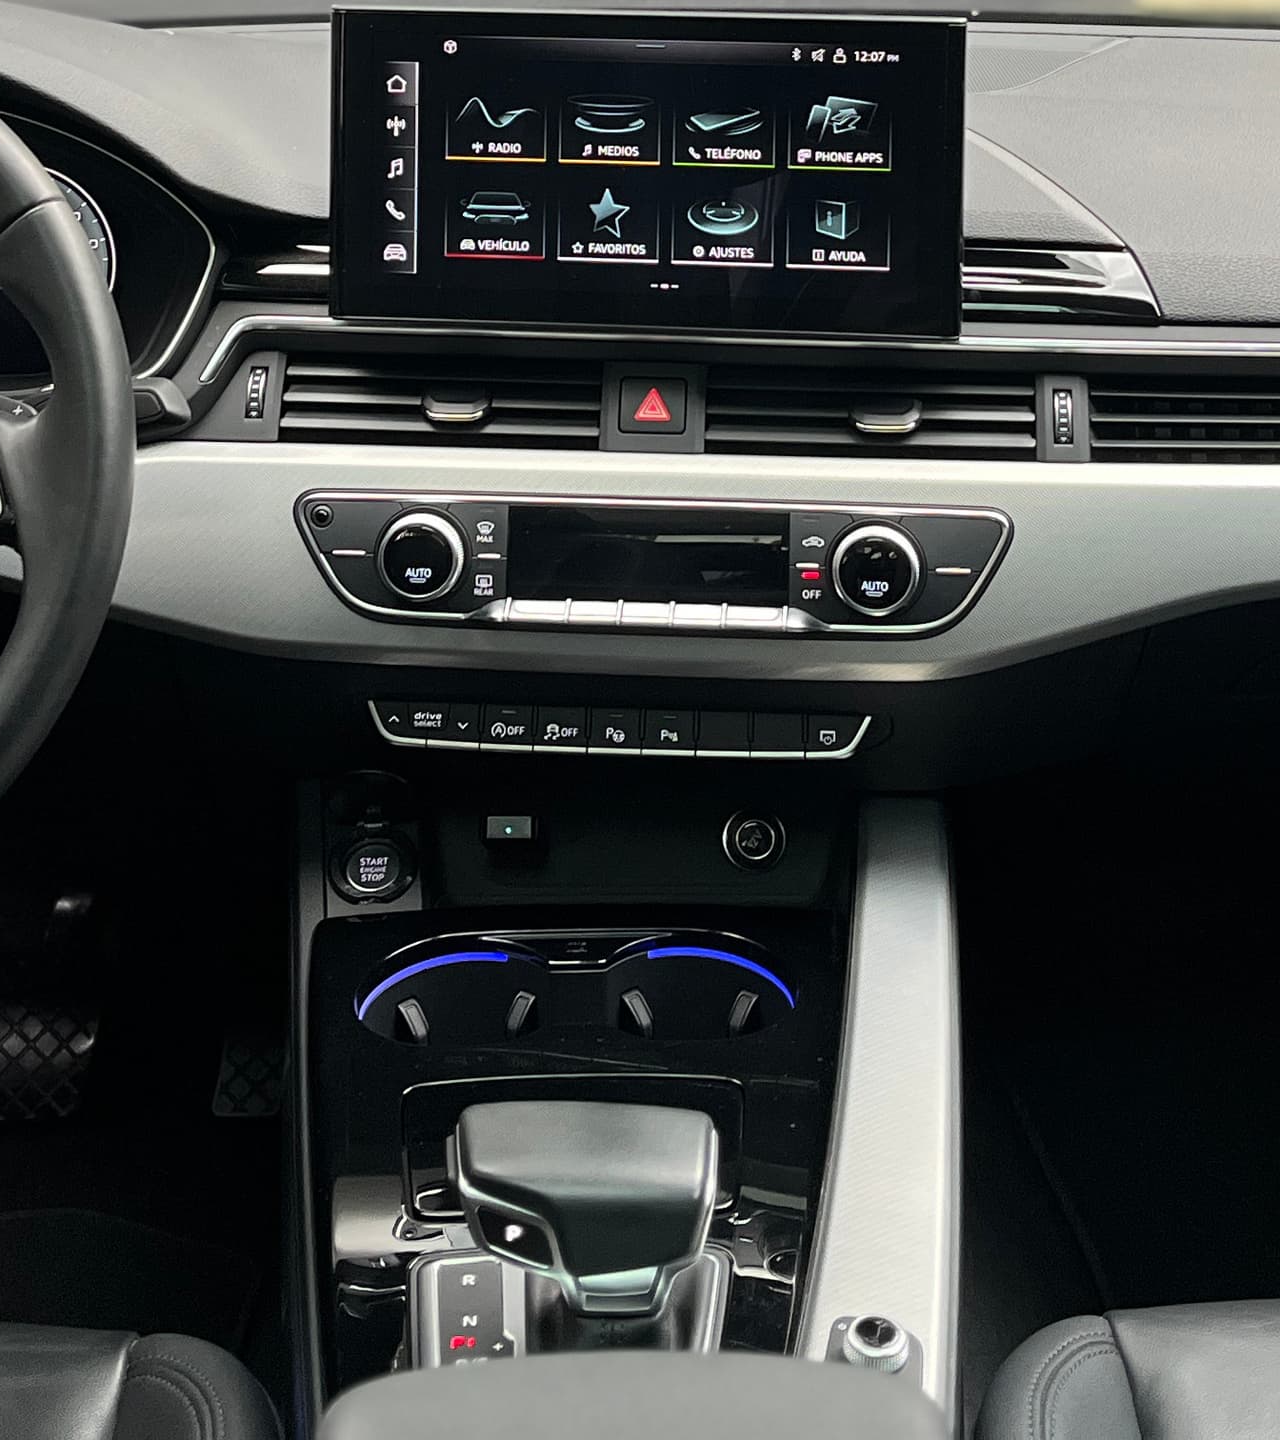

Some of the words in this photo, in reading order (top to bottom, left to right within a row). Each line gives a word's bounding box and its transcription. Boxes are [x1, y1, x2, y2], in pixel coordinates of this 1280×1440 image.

[854, 51, 885, 62] 12:07
[887, 54, 899, 62] PM
[488, 143, 521, 153] RADIO
[598, 145, 639, 157] MEDIOS
[705, 146, 761, 160] TELÉFONO
[815, 151, 853, 162] PHONE
[855, 152, 883, 163] APPS
[477, 238, 530, 252] VEHÍCULO
[588, 243, 646, 255] FAVORITOS
[709, 246, 754, 259] AJUSTES
[828, 250, 866, 262] AYUDA
[476, 535, 493, 543] MAX
[405, 568, 432, 577] AUTO
[861, 581, 889, 591] AUTO
[473, 588, 493, 596] REAR
[802, 589, 821, 599] OFF
[414, 711, 442, 720] drive
[507, 726, 525, 736] OFF
[561, 727, 579, 737] OFF
[360, 857, 389, 866] START
[361, 874, 384, 882] STOP
[505, 1224, 523, 1242] P
[462, 1274, 476, 1286] R
[462, 1315, 477, 1327] N
